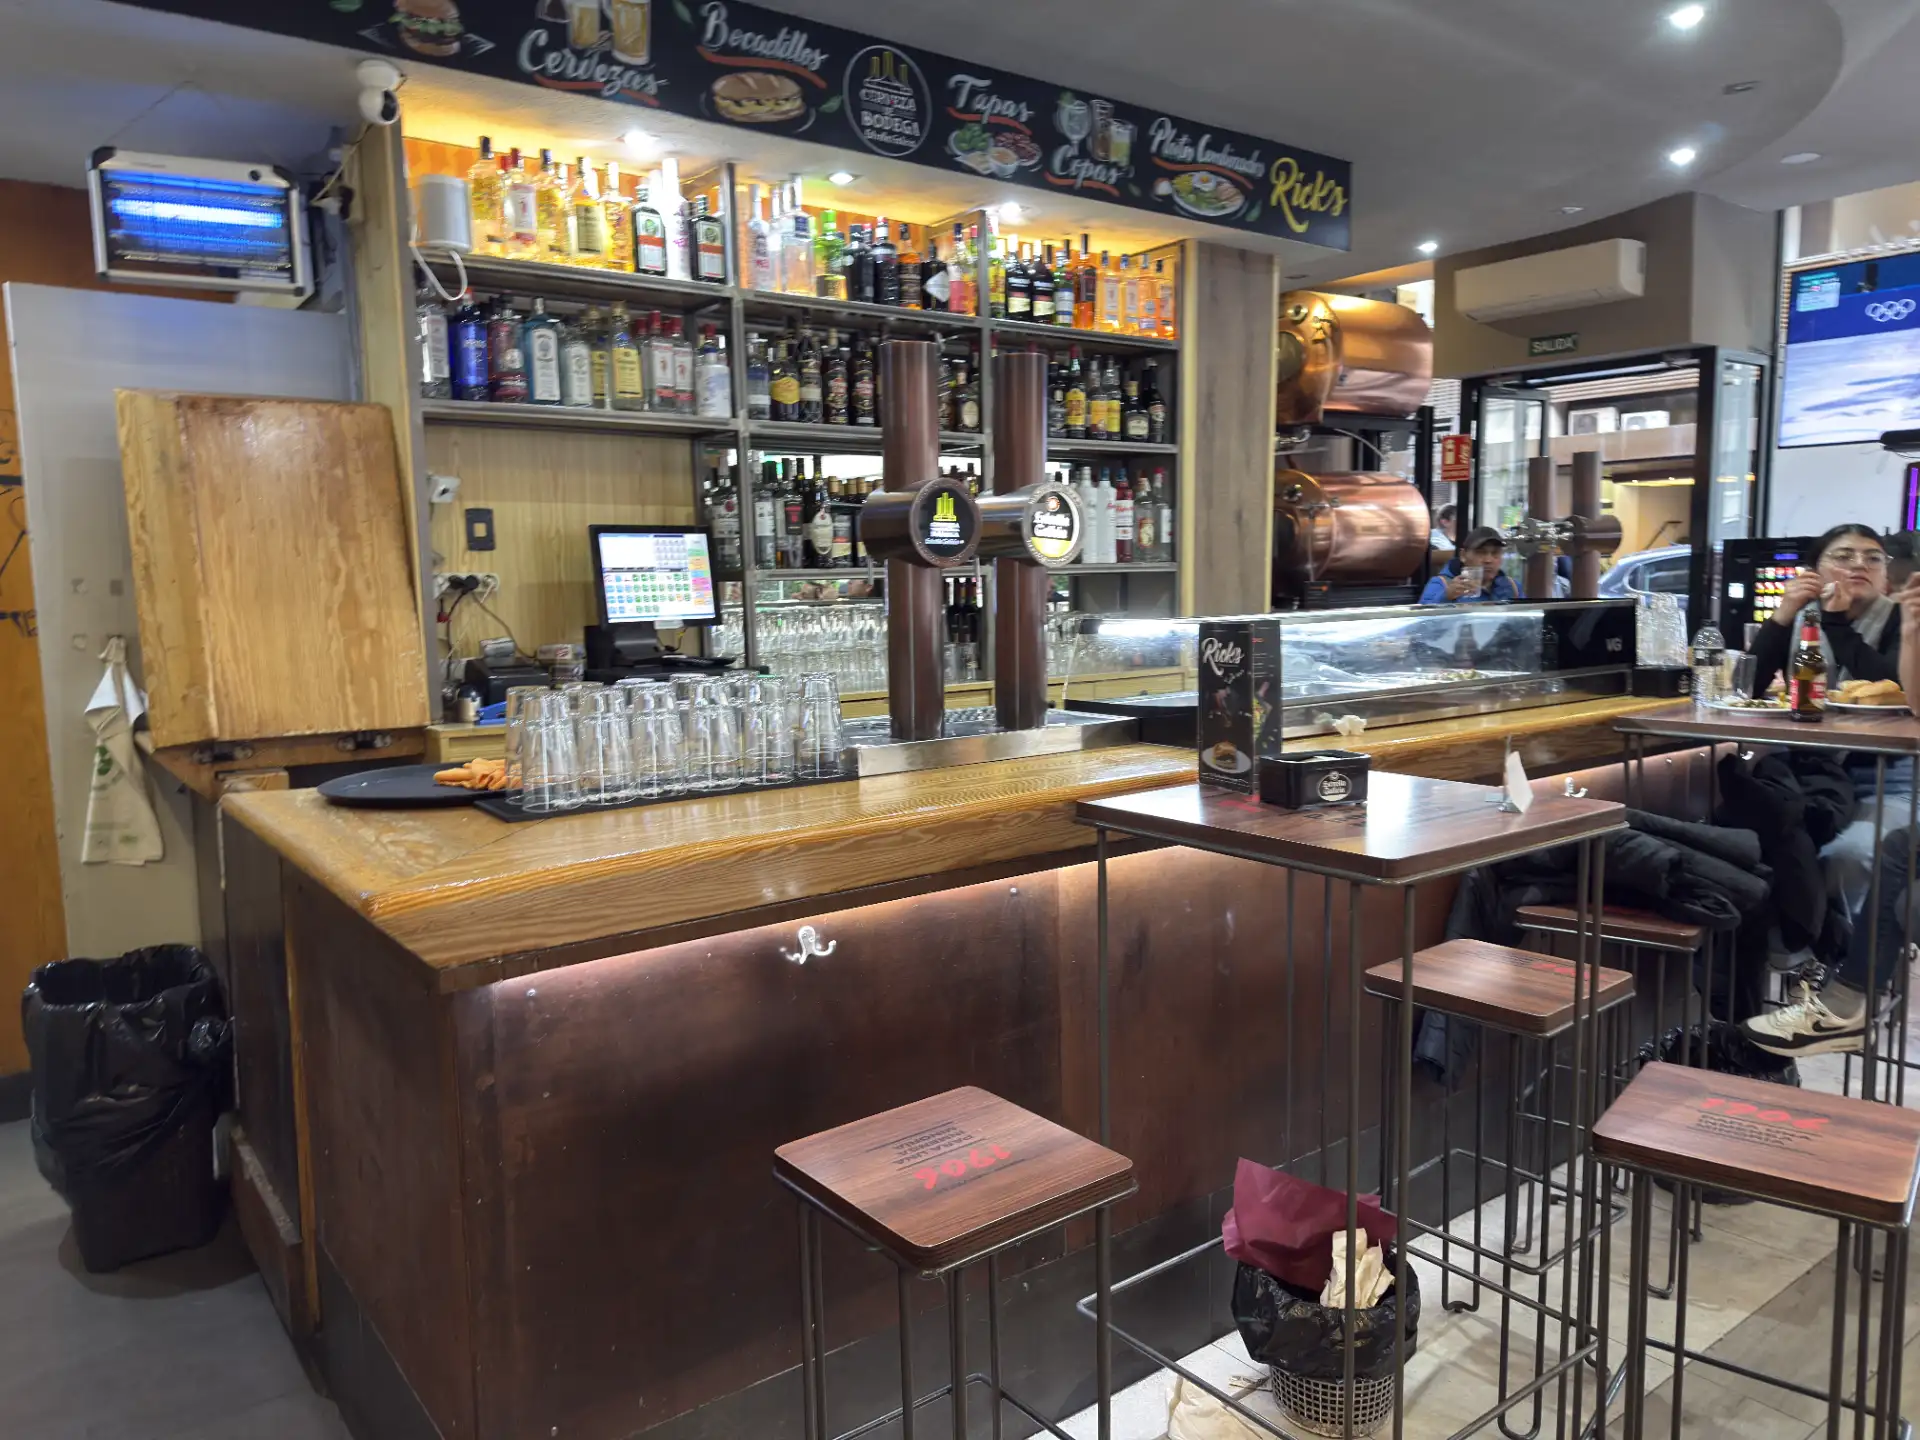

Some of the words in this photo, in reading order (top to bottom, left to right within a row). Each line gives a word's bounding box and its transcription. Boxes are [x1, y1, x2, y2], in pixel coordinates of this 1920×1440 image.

[701, 1, 829, 71] Bocadillos
[519, 29, 670, 97] Cervezas
[948, 74, 1035, 124] Tapas
[861, 111, 920, 137] BODEGA
[1052, 144, 1125, 190] Copas
[1531, 336, 1576, 353] SALIDA
[1702, 1098, 1830, 1130] 1906
[914, 1144, 1012, 1191] 1906
